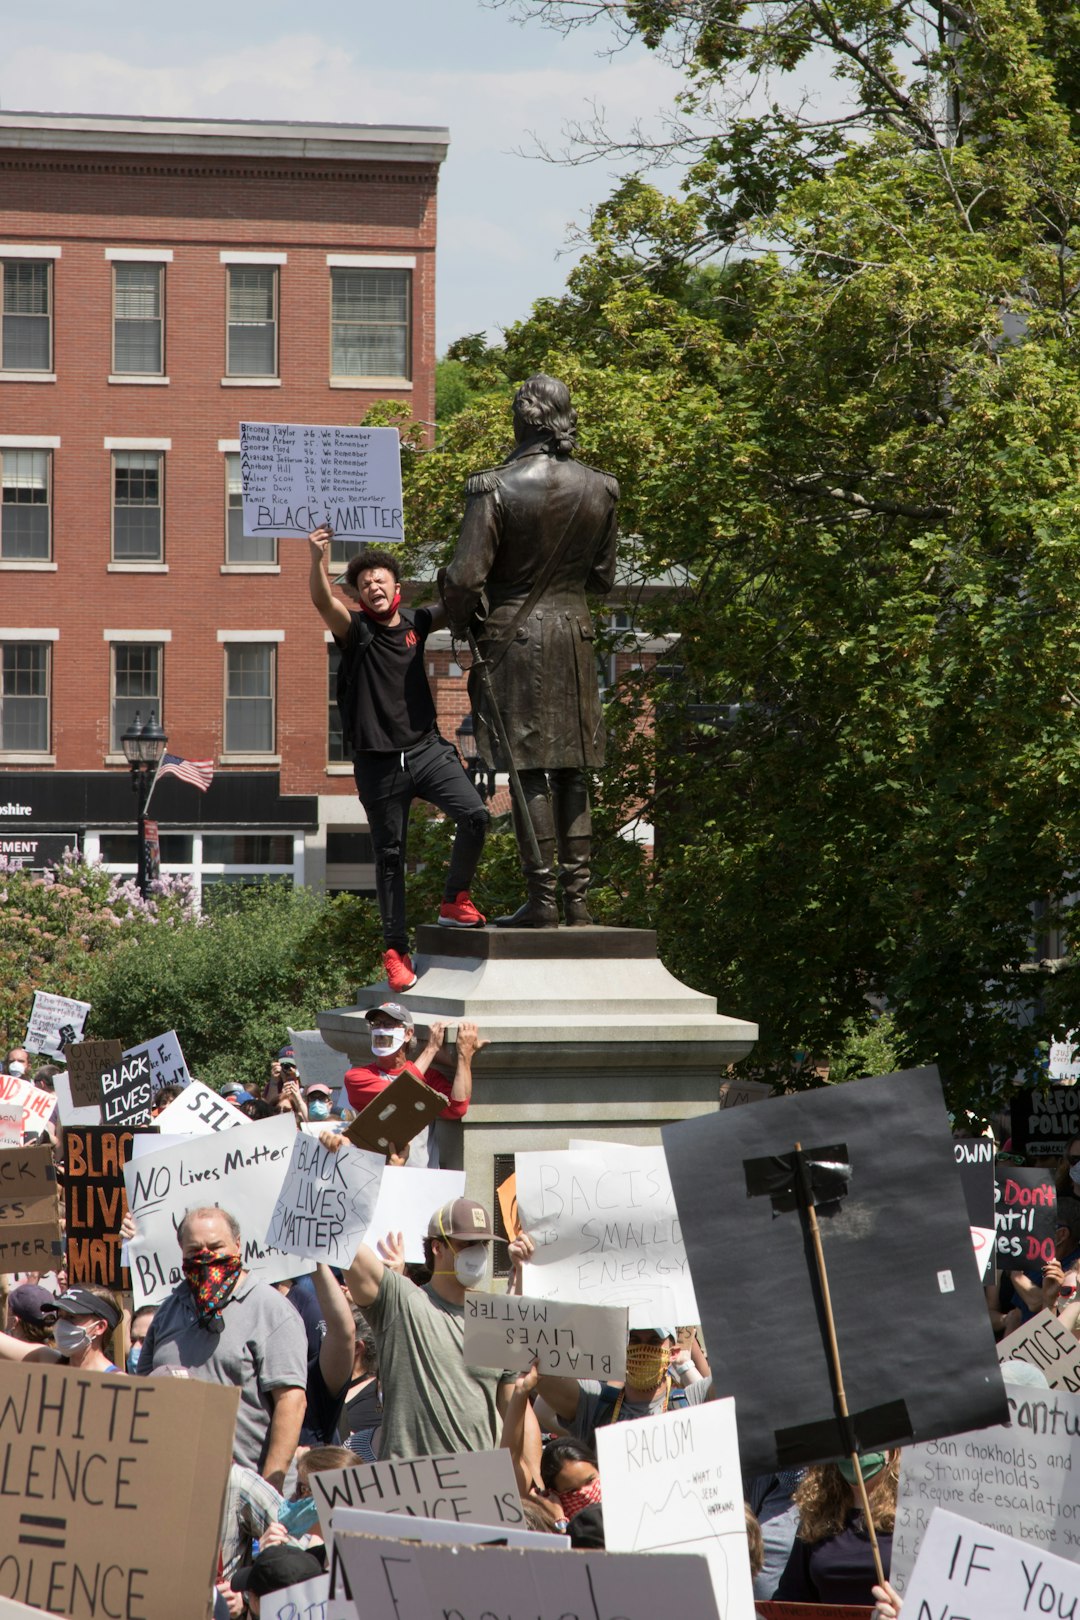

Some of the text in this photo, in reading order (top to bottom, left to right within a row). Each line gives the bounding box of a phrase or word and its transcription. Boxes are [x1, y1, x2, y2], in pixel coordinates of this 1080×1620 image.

[241, 424, 270, 435] Breonna
[270, 425, 296, 437] Taylor
[320, 429, 331, 438] We
[335, 430, 371, 440] Remember
[334, 439, 369, 448] Remember
[240, 441, 269, 451] George
[272, 445, 290, 454] Floyd
[322, 449, 332, 457] We
[320, 457, 332, 465] We
[334, 458, 368, 467] Remember
[241, 460, 272, 472] Anthony
[277, 464, 291, 474] Hill
[320, 467, 331, 476] We
[334, 468, 368, 477] Remember
[241, 471, 268, 482] Walter
[273, 474, 294, 483] Scott
[243, 482, 266, 492] Jordan
[273, 484, 292, 492] Davis
[333, 485, 368, 493] Remember
[243, 493, 265, 503] Tamir
[272, 494, 289, 504] Rice
[348, 495, 386, 503] Remember
[258, 505, 403, 531] BLACK MATTER
[71, 1043, 113, 1058] OVER
[157, 1043, 172, 1063] For
[101, 1056, 149, 1095] BLACK
[105, 1083, 150, 1121] LIVES
[1031, 1089, 1080, 1114] REFO
[67, 1132, 133, 1177] BLAC
[297, 1141, 349, 1189] BLACK
[131, 1144, 289, 1210] NO Lives Matter
[296, 1180, 346, 1222] LIVES
[1004, 1179, 1056, 1208] Don't
[994, 1208, 1035, 1232] ntil
[278, 1207, 344, 1260] MATTER
[541, 1230, 559, 1246] IS
[1026, 1235, 1056, 1263] DO
[577, 1256, 688, 1289] ENERGY
[466, 1299, 547, 1323] MATTER
[506, 1328, 575, 1348] LIVES
[528, 1347, 611, 1373] BLACK
[0, 1373, 155, 1443] WHITE
[624, 1418, 695, 1472] RACISM
[965, 1442, 1037, 1470] chokholds
[1047, 1453, 1073, 1471] and
[1, 1443, 137, 1510] LENCE
[315, 1457, 467, 1510] WHITE
[924, 1461, 1040, 1491] Strangleholds
[702, 1485, 718, 1500] SEEN
[493, 1493, 523, 1524] IS
[1020, 1521, 1056, 1542] before
[948, 1535, 995, 1587] IF
